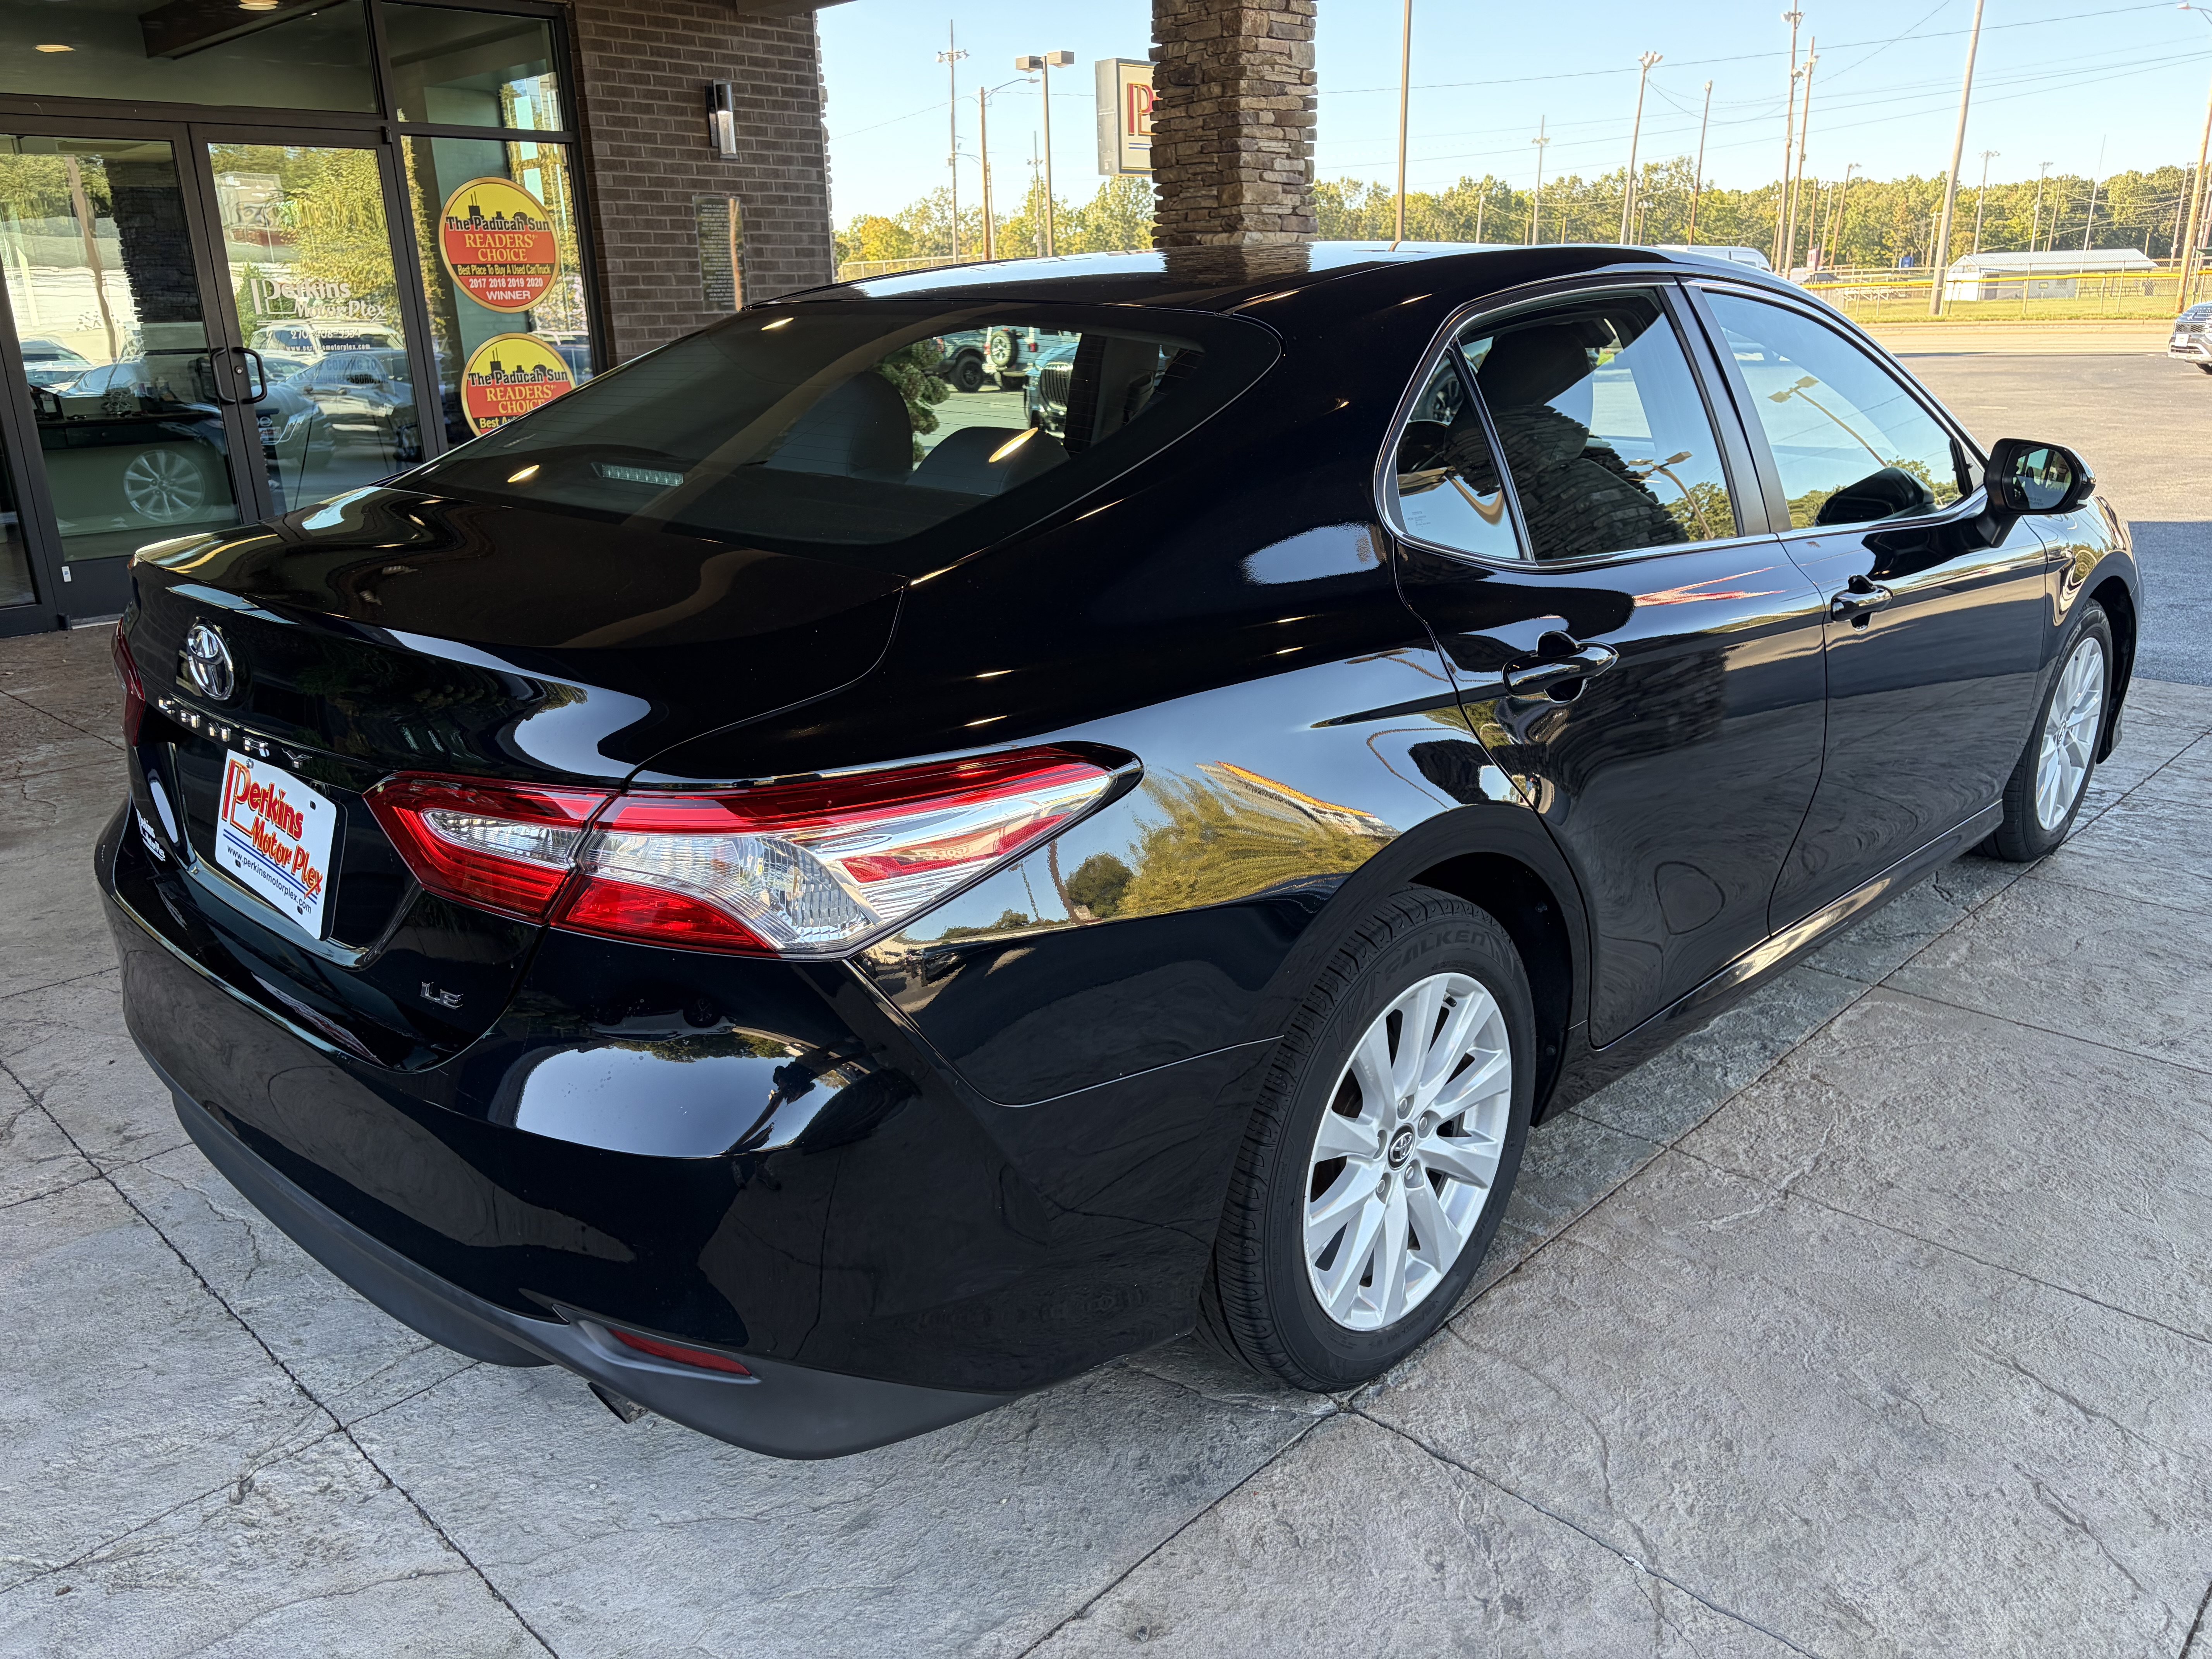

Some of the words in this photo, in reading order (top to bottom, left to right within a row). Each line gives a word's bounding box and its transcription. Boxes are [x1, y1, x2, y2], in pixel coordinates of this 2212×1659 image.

[446, 216, 471, 231] The
[472, 215, 525, 232] Paducah
[527, 217, 551, 232] Sun
[478, 248, 527, 261] CHOICE
[457, 264, 471, 275] Best
[471, 264, 486, 275] Place
[486, 264, 494, 275] To
[494, 264, 505, 276] Buy
[507, 264, 511, 275] A
[512, 264, 525, 275] Used
[469, 278, 486, 288] 2017
[488, 278, 506, 288] 2018
[507, 278, 524, 288] 2019
[526, 277, 543, 287] 2020
[250, 278, 351, 315] Perkins
[486, 290, 531, 300] WINNER
[295, 299, 348, 317] Motor
[349, 300, 386, 323] Plex
[286, 343, 370, 352] www.persmotorplex.com
[326, 359, 362, 370] COMING
[367, 359, 377, 370] TO
[468, 373, 492, 386] The
[494, 368, 543, 385] Paducah
[545, 368, 568, 382] Sun
[479, 417, 500, 428] Best
[158, 696, 313, 769] CAMRY
[222, 758, 304, 841] Perkins
[252, 815, 293, 867] Motor
[291, 844, 324, 899] Plex
[227, 844, 312, 914] www.perkinsmotorplex.com
[1384, 931, 1487, 982] FALKEN
[420, 982, 464, 1010] LE
